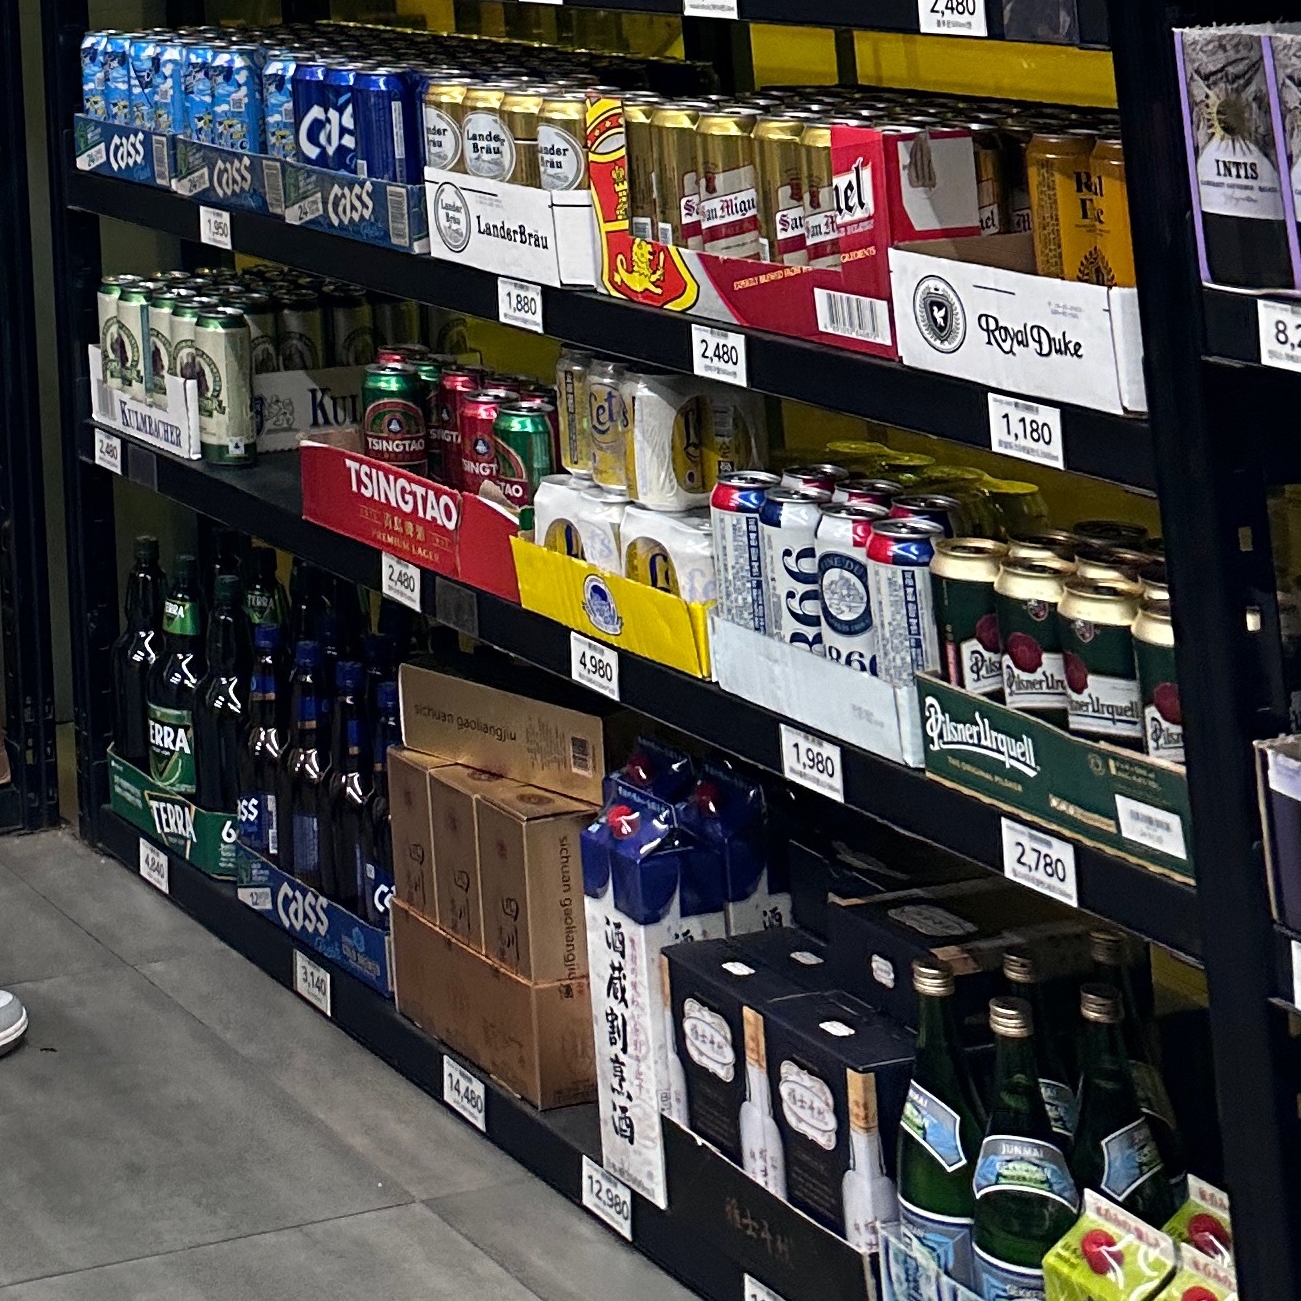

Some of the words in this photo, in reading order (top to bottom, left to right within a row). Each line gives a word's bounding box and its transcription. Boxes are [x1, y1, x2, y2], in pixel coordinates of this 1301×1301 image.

[1215, 158, 1259, 180] INTIS
[506, 290, 537, 318] 1,880
[978, 311, 1029, 359] Royal
[1030, 324, 1084, 359] Duke
[700, 342, 739, 368] 2,480
[118, 399, 183, 448] KULMBACHER
[1001, 412, 1053, 446] 1,180
[368, 436, 425, 452] TSINGTAO
[345, 458, 458, 531] TSINGTAO
[388, 567, 415, 595] 2,480
[578, 653, 612, 683] 4,980
[413, 703, 455, 726] sichuan
[456, 712, 518, 743] gaoliangjiu
[790, 741, 834, 779] 1,980
[149, 798, 197, 843] TERRA
[1014, 841, 1067, 883] 2,780
[301, 967, 327, 997] 3,140
[446, 1073, 484, 1113] 14,480
[586, 1172, 631, 1222] 12,980
